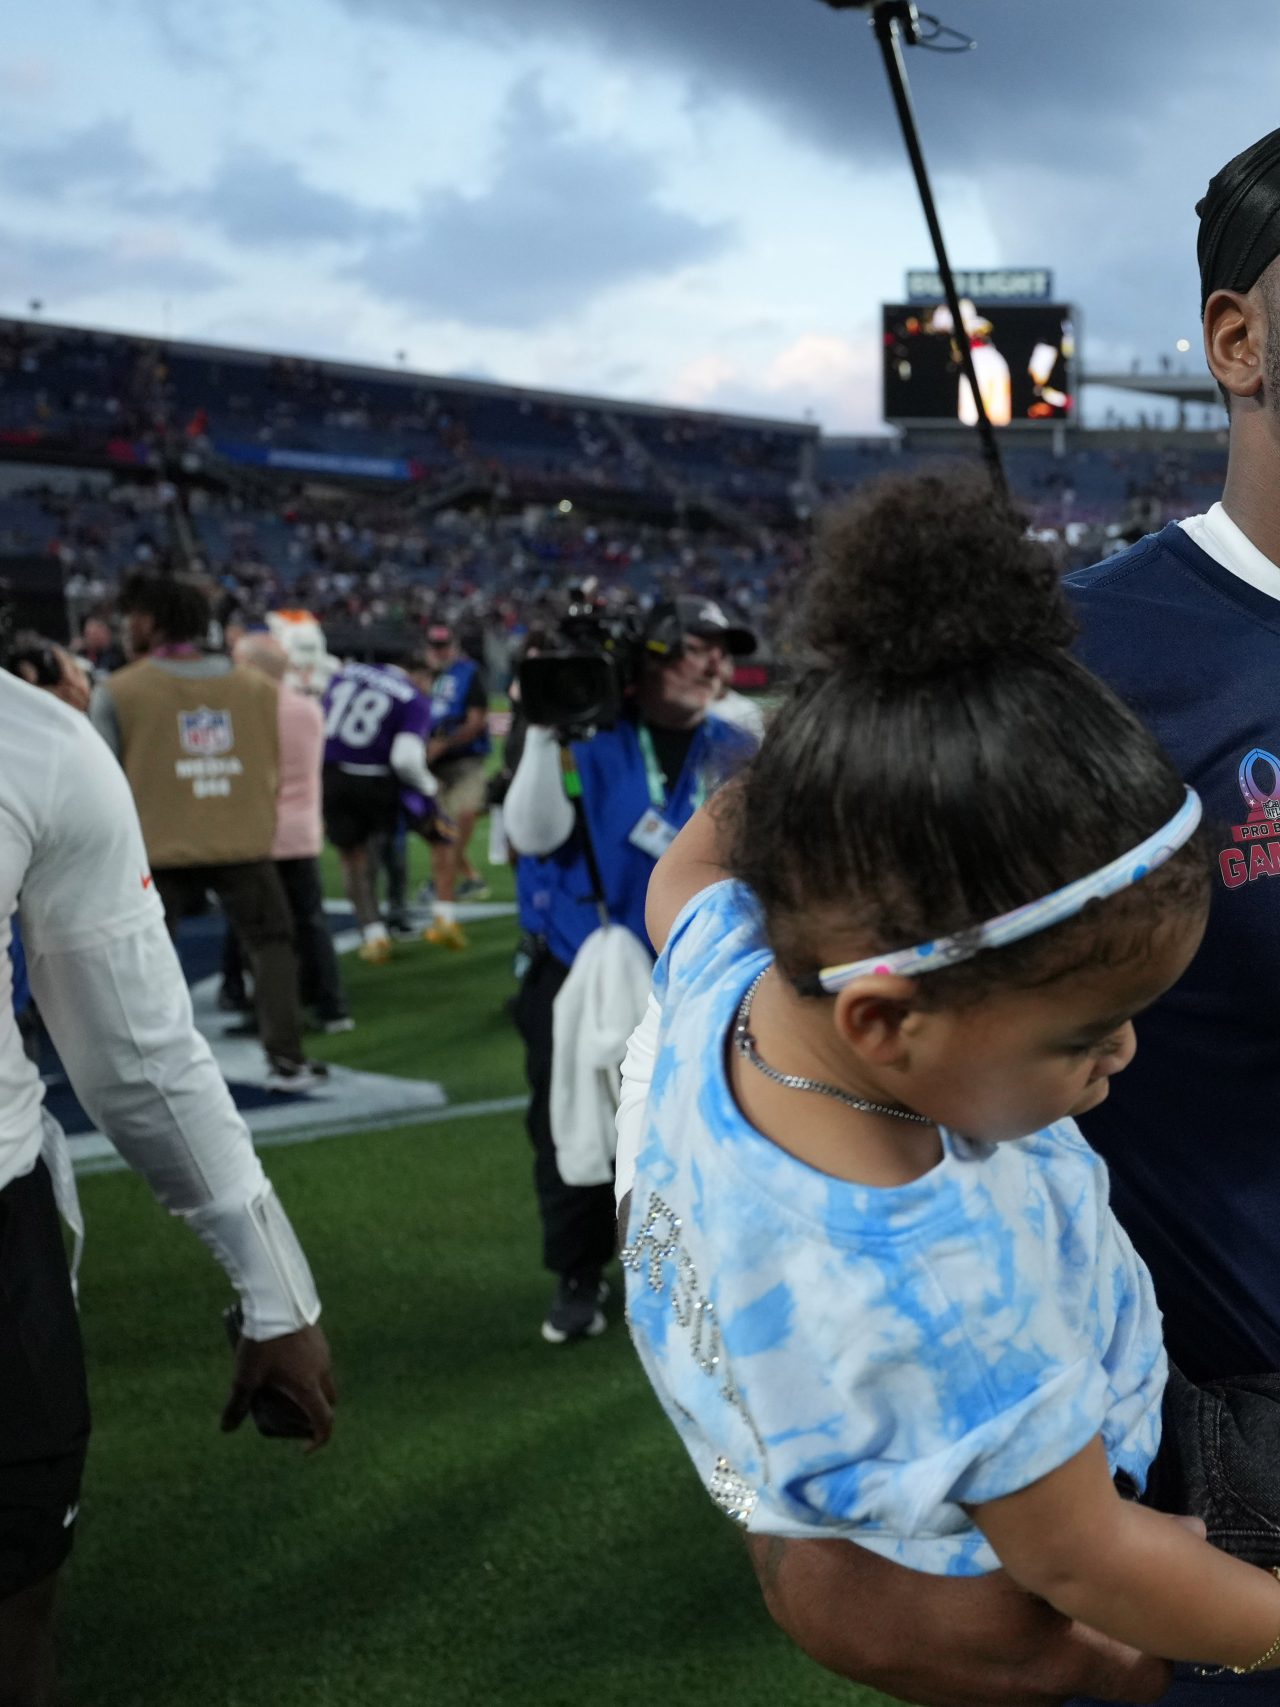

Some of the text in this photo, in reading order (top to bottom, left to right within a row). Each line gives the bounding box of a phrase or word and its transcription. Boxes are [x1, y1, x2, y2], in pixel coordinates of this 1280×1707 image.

[326, 680, 390, 748] 18
[1265, 807, 1280, 818] NFL
[1241, 823, 1269, 838] PRO
